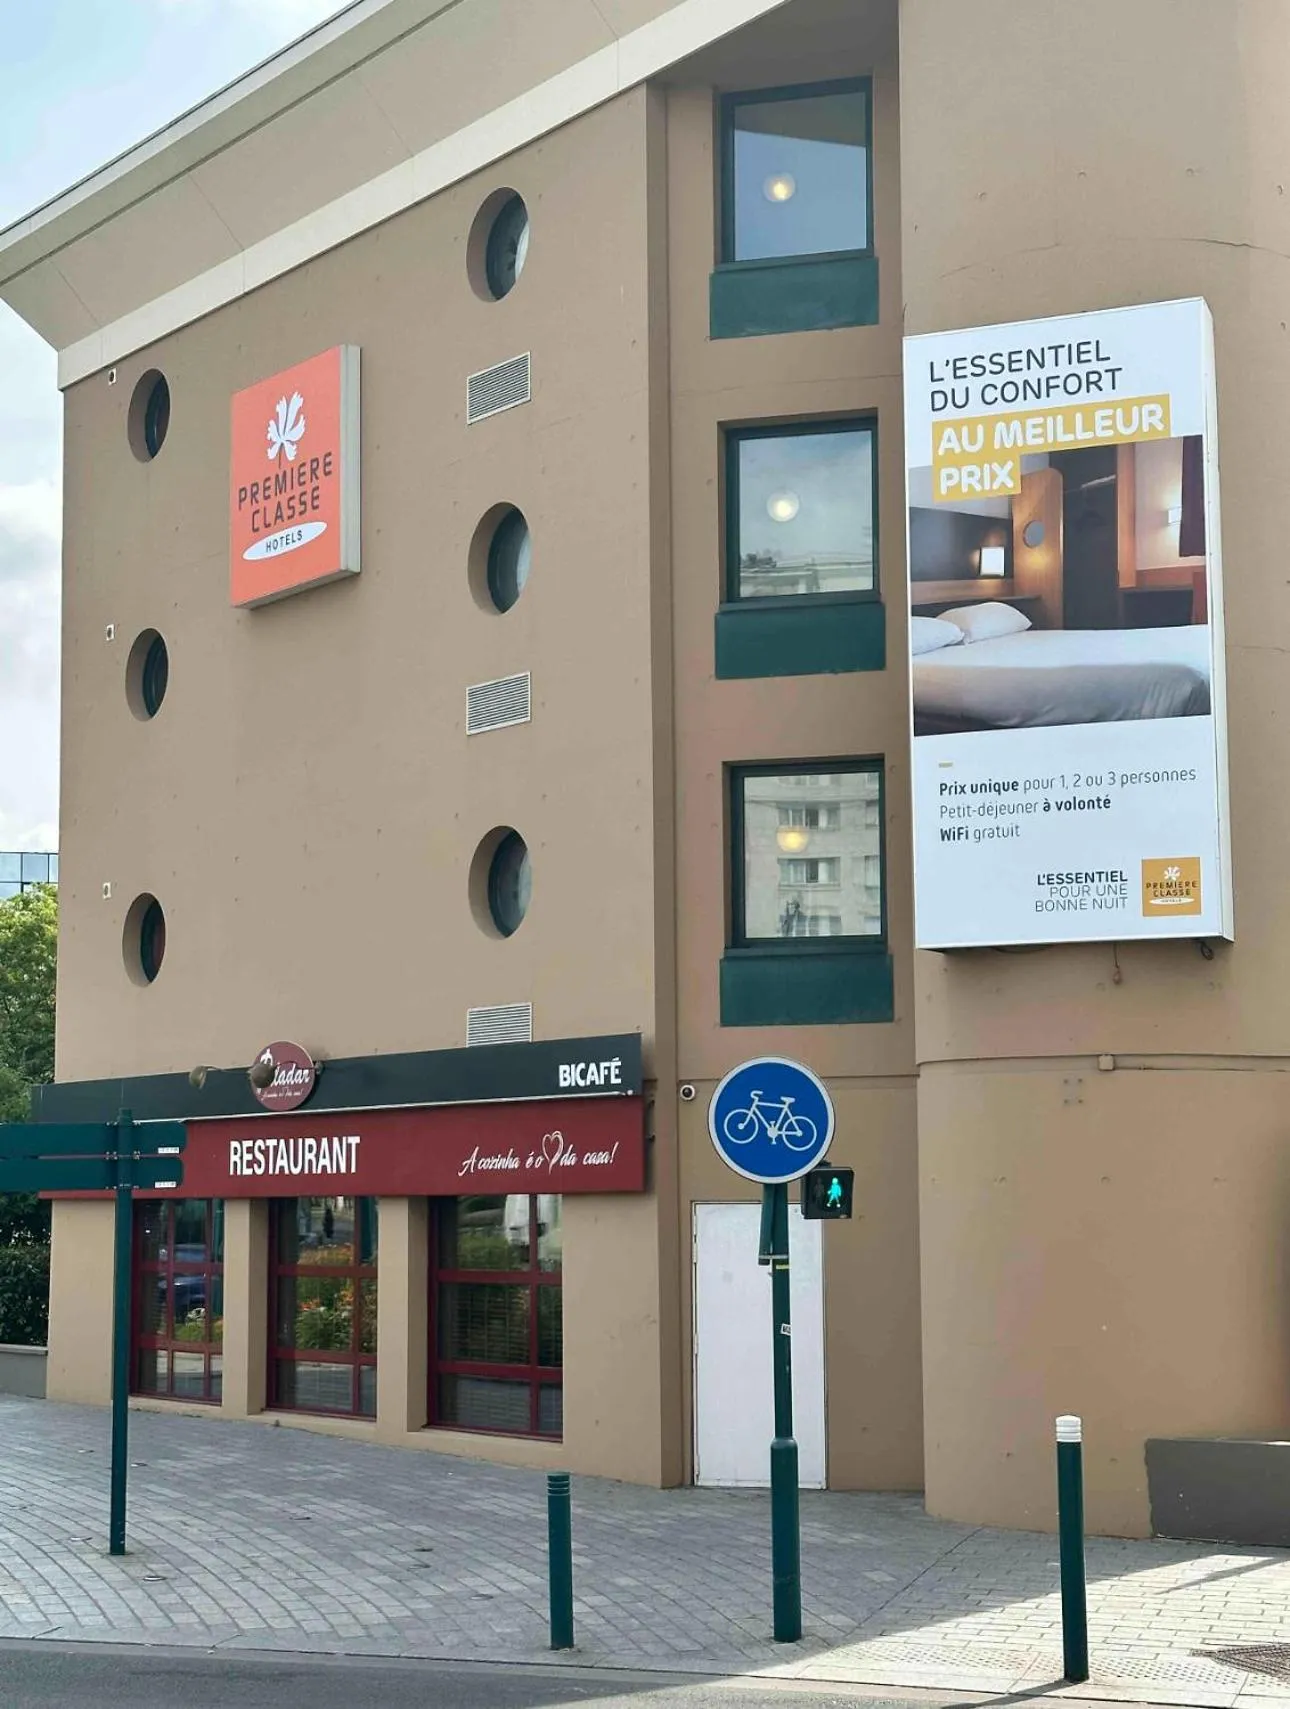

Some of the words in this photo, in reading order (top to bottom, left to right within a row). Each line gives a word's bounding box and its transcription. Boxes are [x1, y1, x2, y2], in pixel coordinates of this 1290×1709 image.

[929, 340, 1111, 382] L'ESSENTIEL
[931, 386, 970, 412] DU
[981, 368, 1123, 405] CONFORT
[938, 423, 985, 456] AU
[994, 403, 1166, 450] MEILLEUR
[238, 452, 333, 511] PREMIERE
[940, 460, 1014, 495] PRIX
[251, 486, 320, 533] CLASSE
[265, 530, 303, 552] HOTELS
[939, 781, 967, 796] Prix
[970, 779, 1019, 797] unique
[1023, 775, 1055, 792] pour
[1060, 774, 1069, 790] 1,
[1073, 773, 1081, 788] 2
[1085, 775, 1103, 786] ou
[1108, 771, 1116, 785] 3
[1120, 768, 1197, 789] personnes
[940, 800, 1038, 820] Petit-déjeuner
[1043, 798, 1051, 812] à
[1055, 795, 1112, 812] volonté
[940, 826, 969, 842] WiFi
[973, 824, 1020, 844] gratuit
[1037, 870, 1128, 886] L'ESSENTIEL
[1050, 885, 1091, 898] POUR
[1096, 883, 1128, 896] UNE
[1145, 880, 1198, 889] PREMIERE
[1035, 899, 1087, 912] BONNE
[1092, 897, 1128, 910] NUIT
[1153, 889, 1191, 897] CLASSE
[558, 1057, 622, 1087] BICAFÉ
[229, 1136, 361, 1176] RESTAURANT
[457, 1146, 480, 1177] A
[477, 1148, 520, 1170] cozinha
[559, 1144, 578, 1167] da
[582, 1141, 619, 1166] casa!
